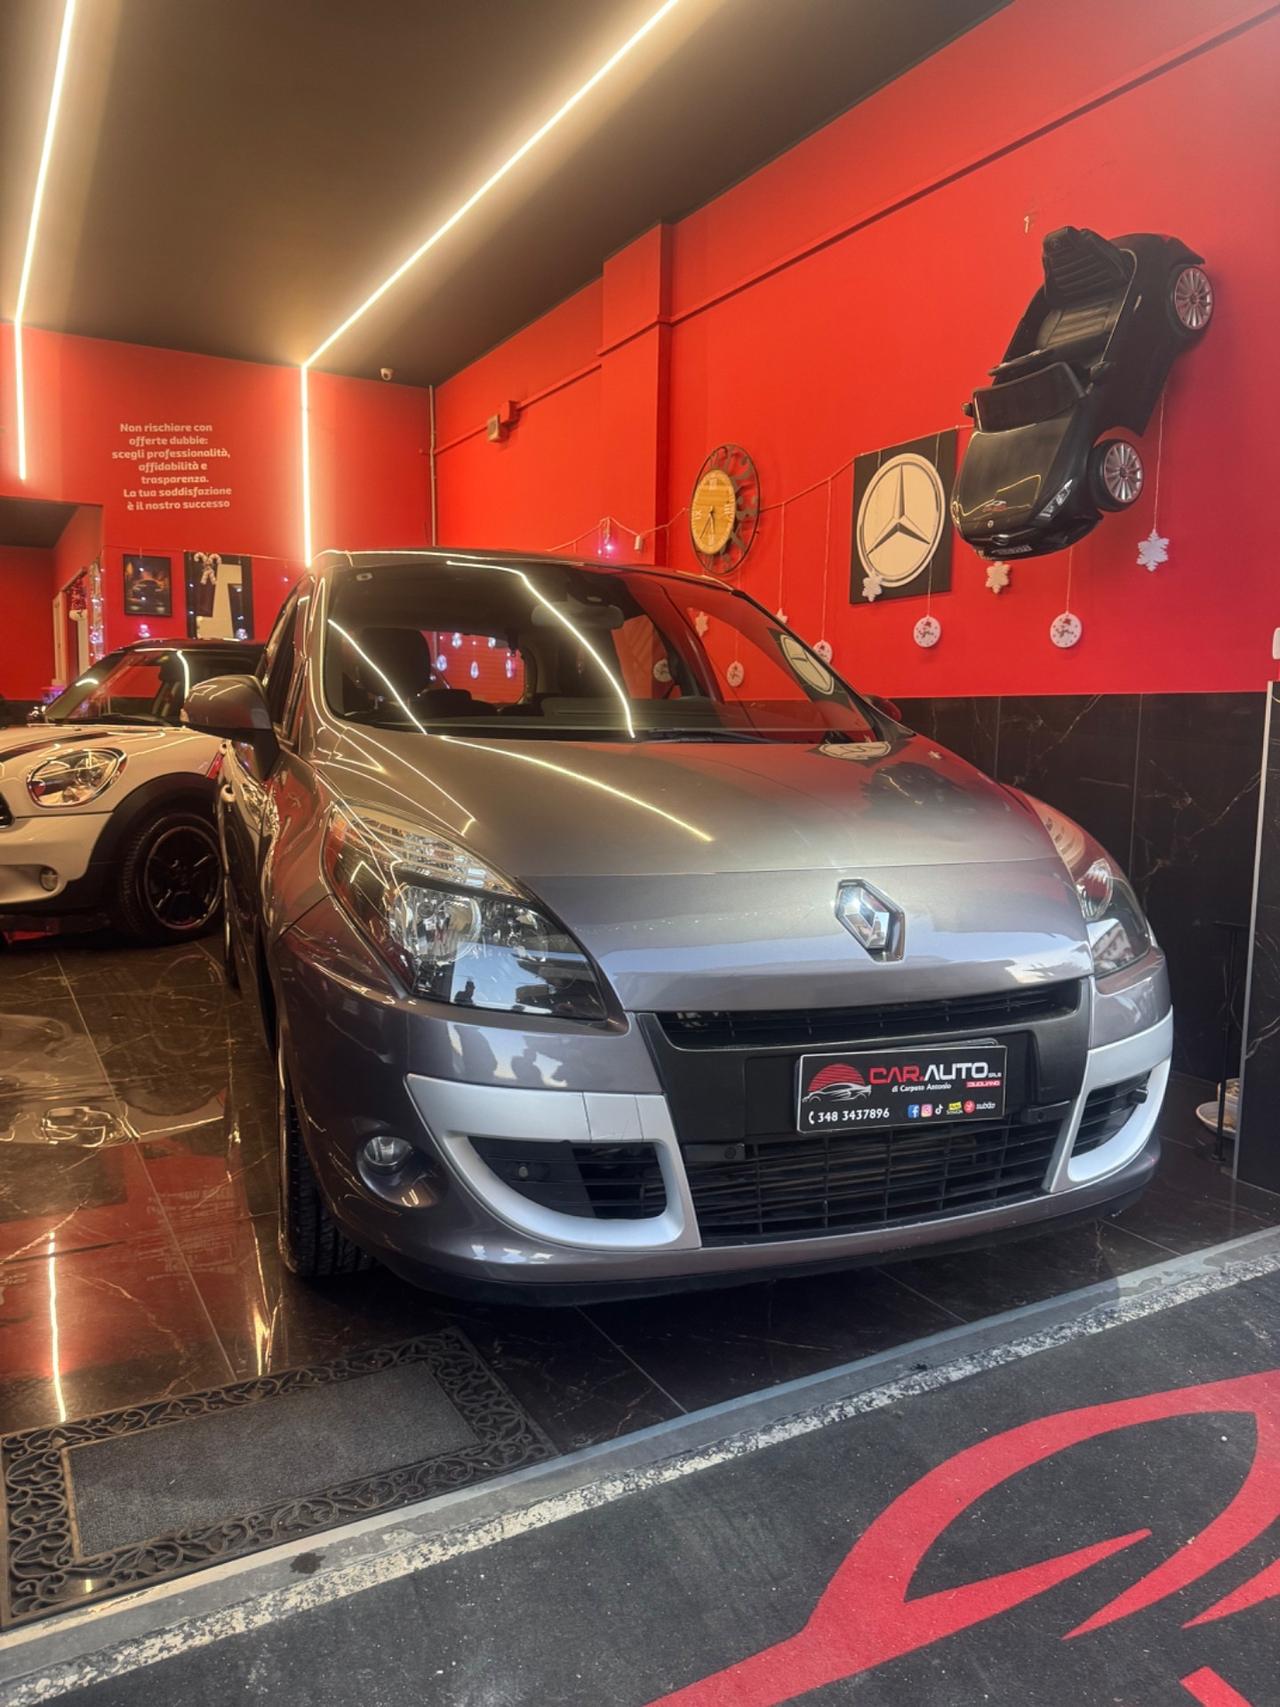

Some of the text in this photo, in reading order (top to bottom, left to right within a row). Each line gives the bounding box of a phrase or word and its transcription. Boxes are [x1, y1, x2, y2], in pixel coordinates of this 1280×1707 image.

[120, 423, 213, 432] Non rischiare con
[128, 436, 208, 447] offerte dubbie:
[111, 448, 231, 460] scegli professionalità,
[138, 461, 199, 473] affidabilità
[141, 475, 209, 485] trasparenza.
[123, 486, 232, 498] La tua soddisfazione
[127, 500, 231, 511] è il nostro successo
[891, 1085, 898, 1093] di
[817, 1108, 890, 1122] 348 3437896
